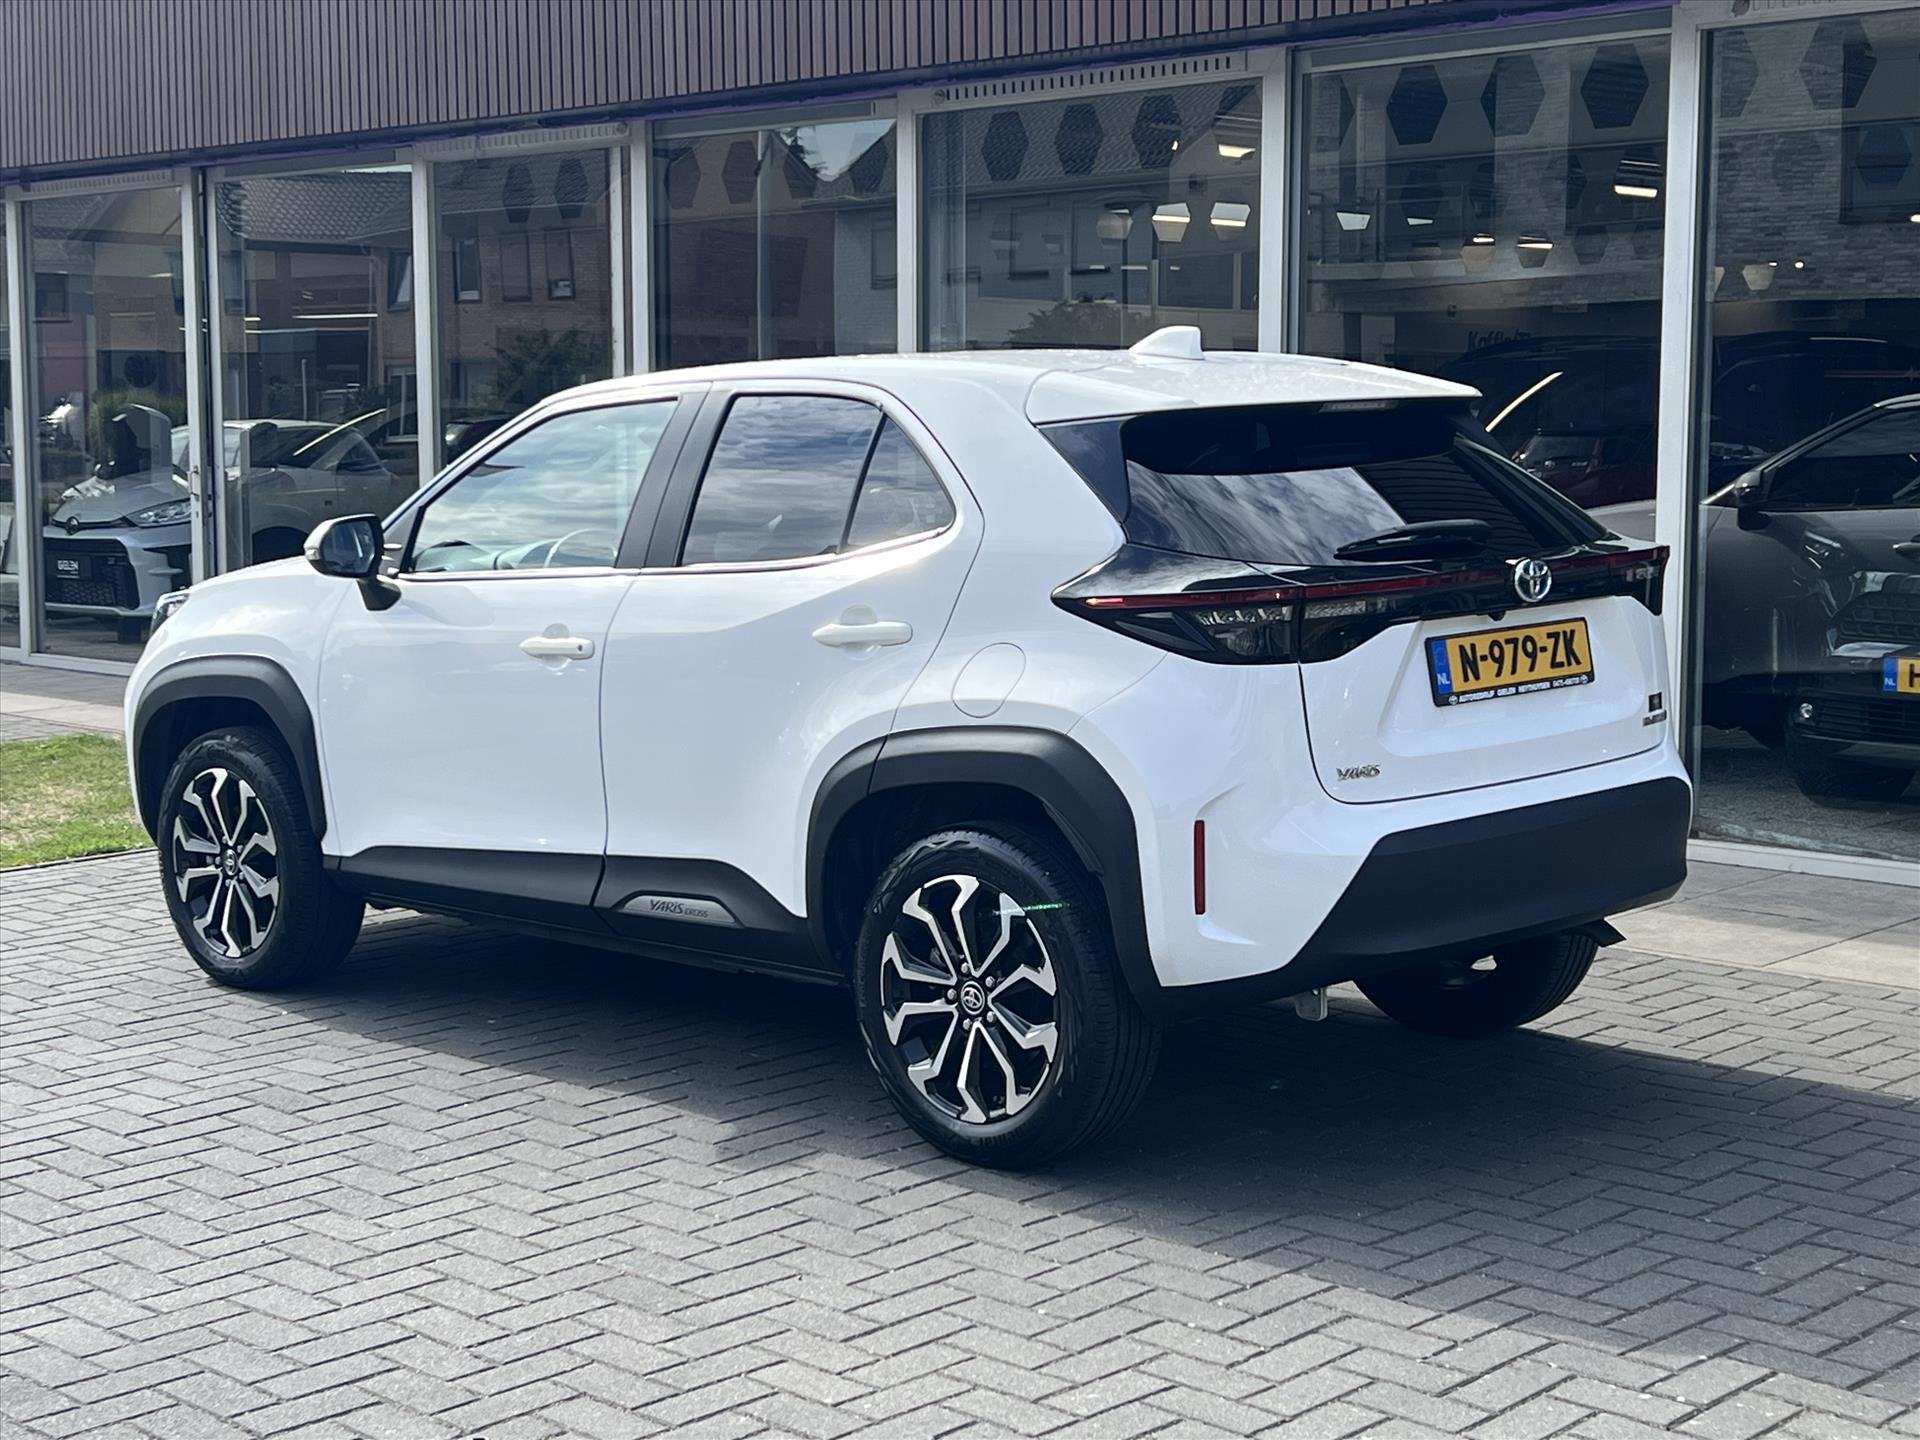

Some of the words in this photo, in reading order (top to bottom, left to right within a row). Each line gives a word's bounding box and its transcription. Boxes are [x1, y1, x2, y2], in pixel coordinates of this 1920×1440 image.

[1458, 629, 1582, 683] N-979-ZK
[1437, 673, 1450, 686] NL
[1885, 677, 1896, 686] NL
[649, 898, 684, 915] YARIS
[684, 907, 709, 918] CROSS
